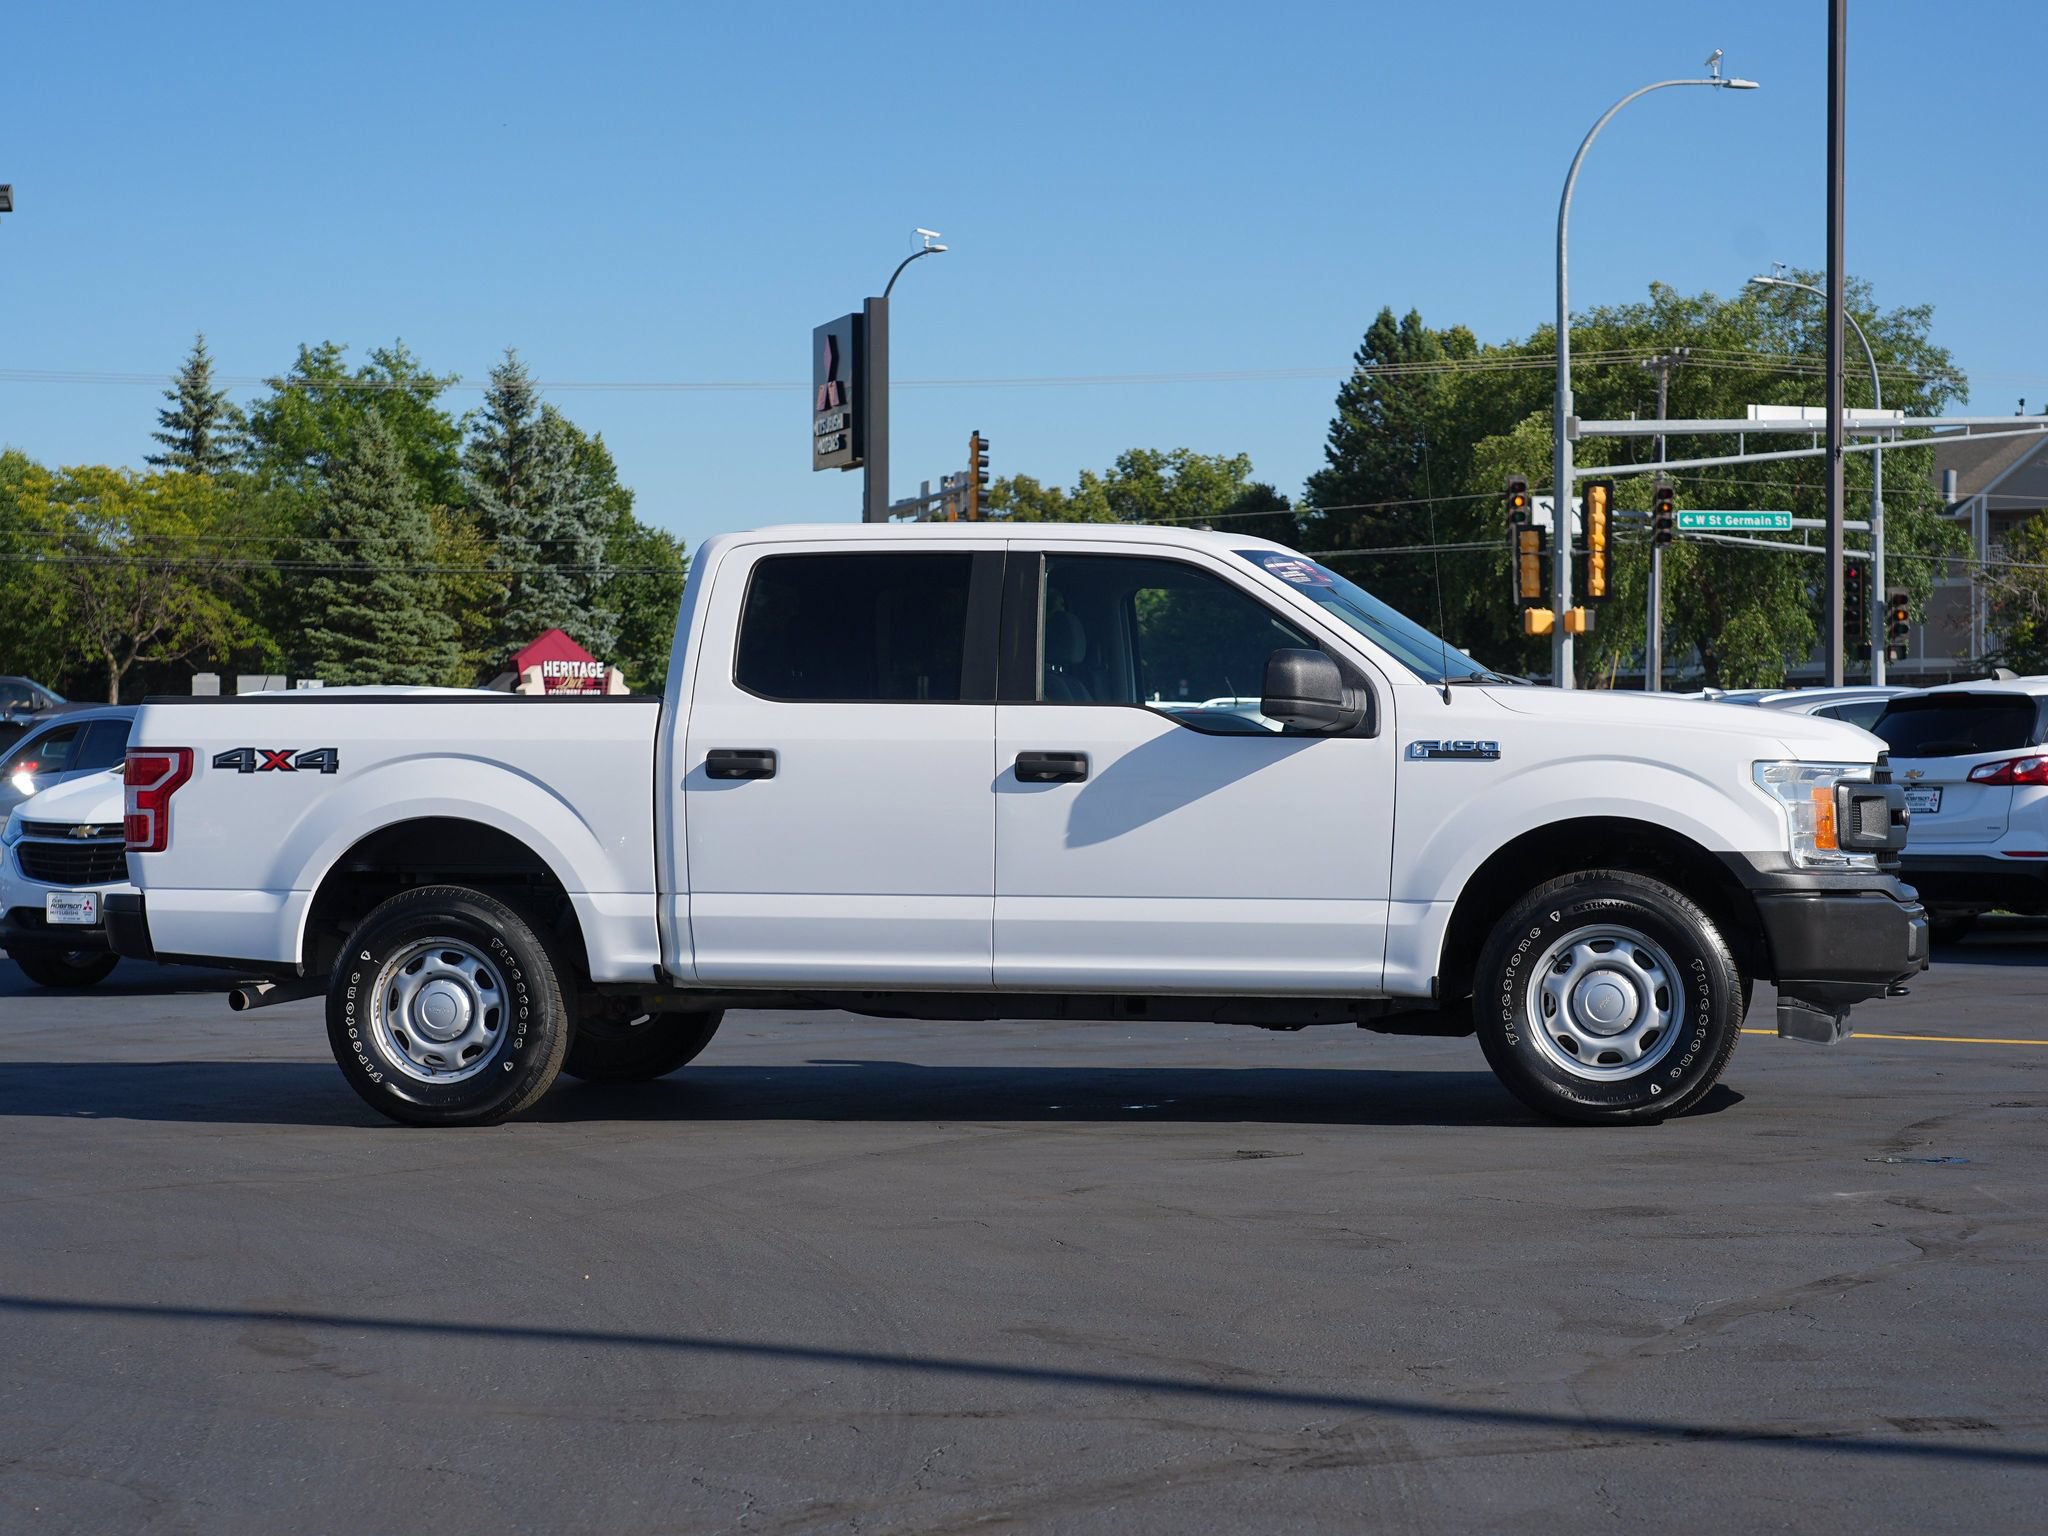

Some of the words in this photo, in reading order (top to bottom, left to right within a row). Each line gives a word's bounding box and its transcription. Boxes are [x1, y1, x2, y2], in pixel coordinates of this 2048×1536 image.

[1696, 515, 1706, 525] W
[1709, 515, 1722, 525] St
[1725, 515, 1772, 525] Germain
[1775, 515, 1788, 526] St
[543, 660, 605, 678] HERITAGE
[345, 971, 385, 1083] Firestone
[490, 937, 529, 1050] Firestone
[1501, 927, 1541, 1047] Firestone
[1670, 958, 1710, 1079] Firestone
